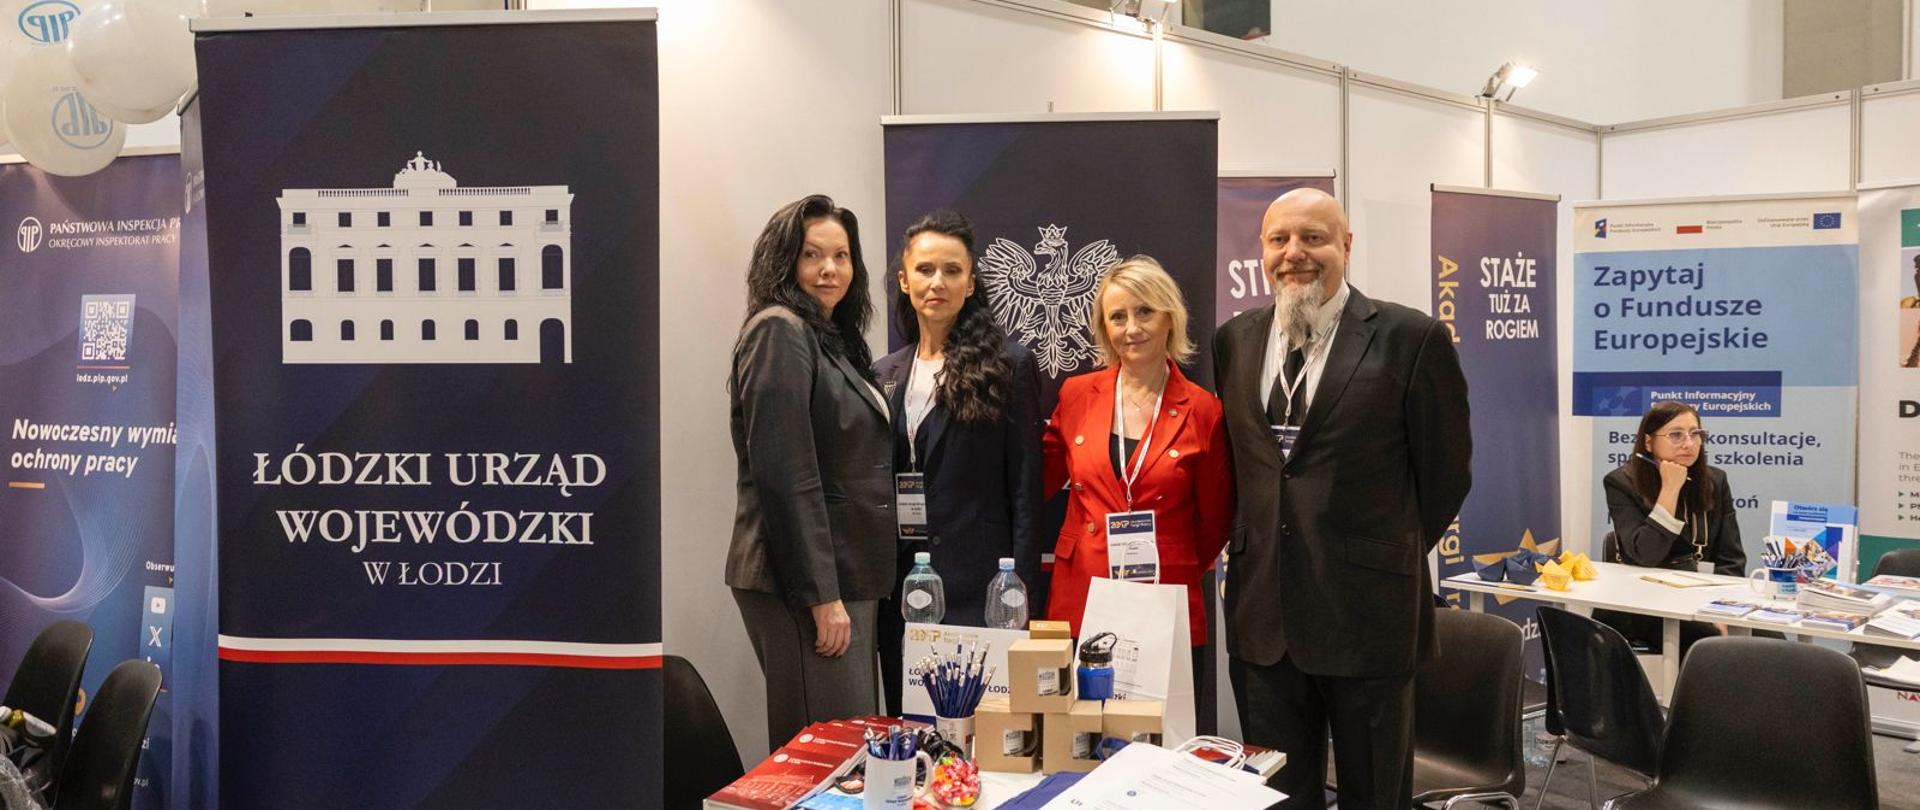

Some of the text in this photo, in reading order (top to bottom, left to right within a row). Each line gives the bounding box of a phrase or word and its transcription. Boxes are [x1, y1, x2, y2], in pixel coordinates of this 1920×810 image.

[50, 219, 114, 234] PAŃSTWOWA
[117, 218, 166, 232] INSPEKCJA
[48, 234, 176, 249] OKRĘGOWY INSPEKTORAT PRACY
[1480, 251, 1536, 288] STAŻE
[1594, 262, 1704, 291] Zapytaj
[1489, 289, 1530, 313] TUŻ ZA
[1594, 296, 1762, 318] o Fundusze
[1486, 320, 1539, 339] ROGIEM
[1594, 326, 1768, 355] Europejskie
[76, 373, 128, 385] lodz.pip.gov.pl
[1650, 391, 1756, 401] Punkt Informacyjny
[1703, 402, 1771, 412] Europejskich
[12, 418, 123, 447] Nowoczesny
[1707, 431, 1821, 448] konsultacje,
[11, 448, 138, 478] ochrony pracy
[252, 443, 607, 497] ŁÓDZKI URZĄD
[1714, 452, 1804, 466] szkolenia
[275, 501, 594, 553] WOJEWÓDZKI
[362, 561, 502, 585] W ŁODZI
